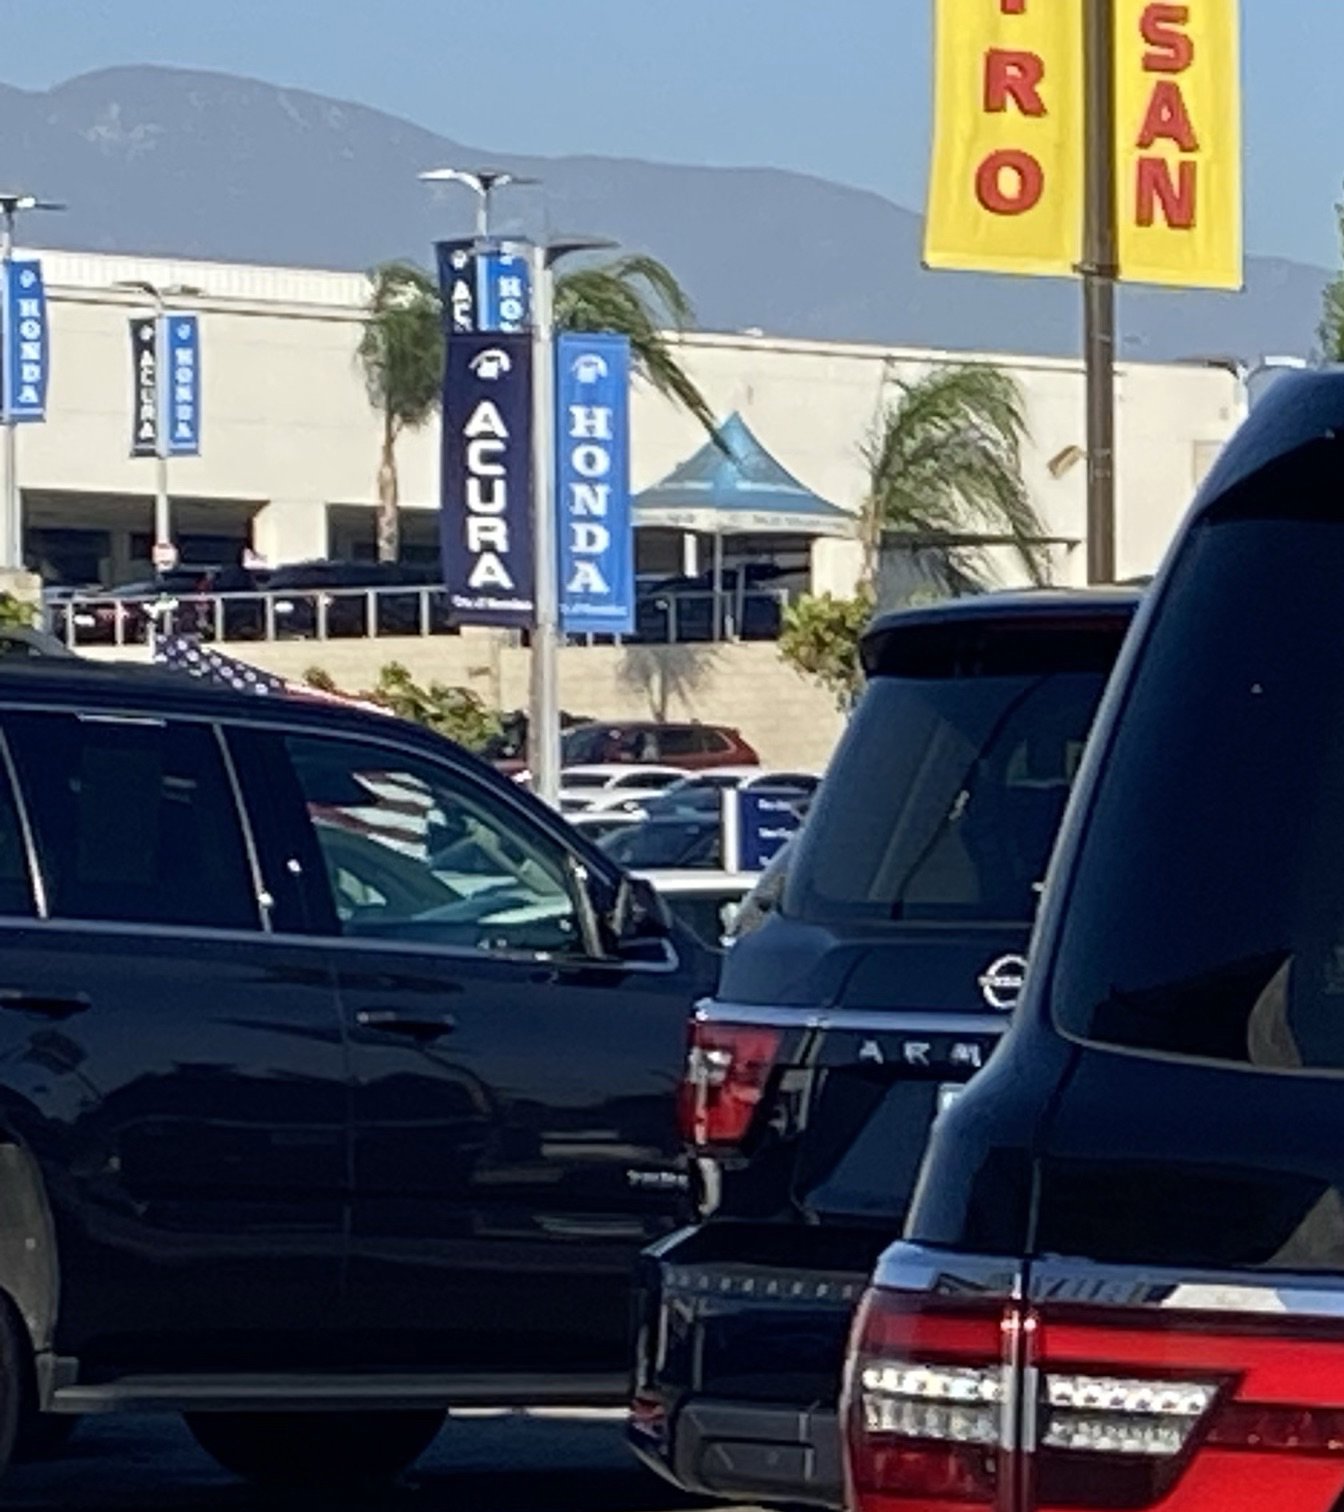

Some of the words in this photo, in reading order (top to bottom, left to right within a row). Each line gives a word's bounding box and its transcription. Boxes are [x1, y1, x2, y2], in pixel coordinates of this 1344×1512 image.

[974, 0, 1048, 216] RO
[1134, 2, 1199, 230] SAN
[17, 298, 42, 404] HONDA
[138, 349, 156, 440] ACURA
[174, 348, 194, 439] HONDA
[463, 400, 515, 590] ACURA
[566, 405, 614, 595] HONDA
